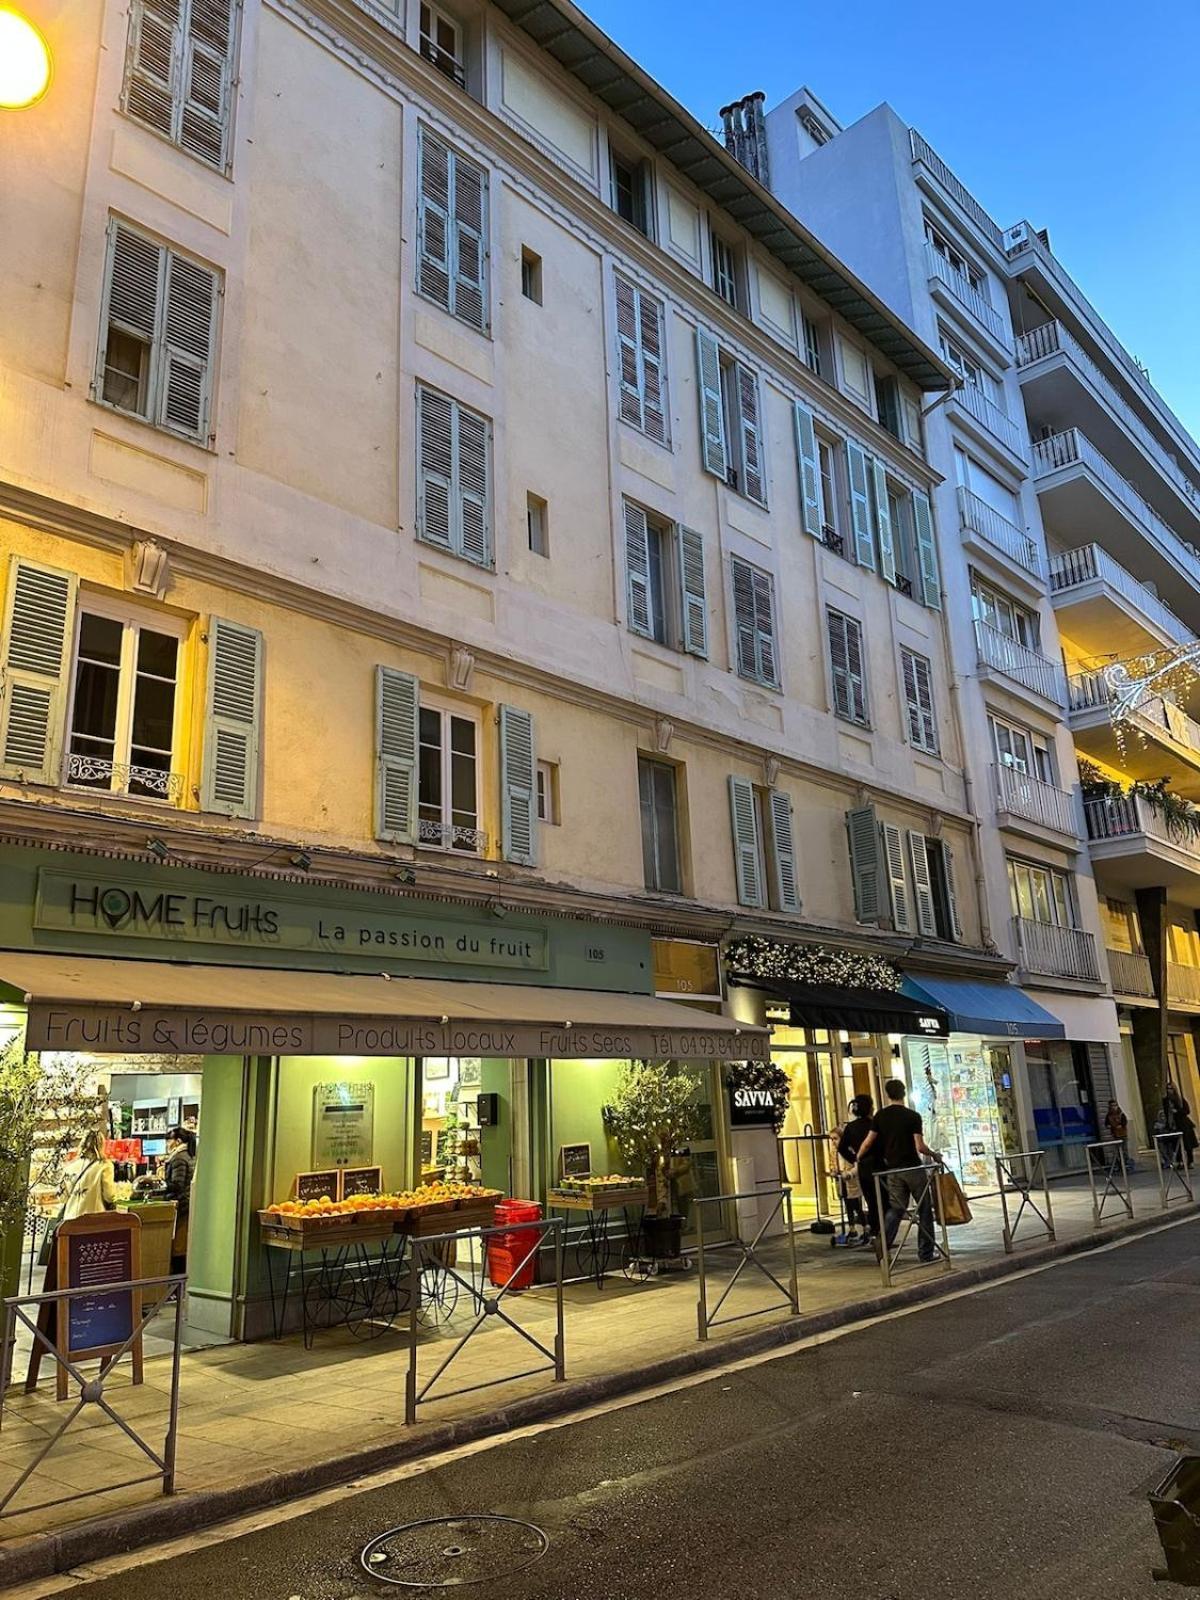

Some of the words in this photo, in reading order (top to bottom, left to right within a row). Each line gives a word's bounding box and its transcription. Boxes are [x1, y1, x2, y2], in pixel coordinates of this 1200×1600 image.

[70, 883, 187, 928] HOME
[193, 897, 279, 934] Fruits
[318, 921, 345, 940] La
[359, 929, 445, 949] passion
[456, 935, 480, 953] du
[489, 938, 531, 958] fruit
[588, 949, 604, 960] 105
[676, 979, 694, 991] 105
[46, 1012, 142, 1043] Fruits
[152, 1019, 179, 1049] &
[184, 1017, 303, 1051] légumes
[337, 1023, 436, 1050] Produits
[441, 1028, 516, 1051] Locaux
[539, 1031, 587, 1053] Fruits
[592, 1032, 633, 1053] Secs
[651, 1034, 676, 1054] Tél.
[734, 1089, 774, 1107] SAVVA
